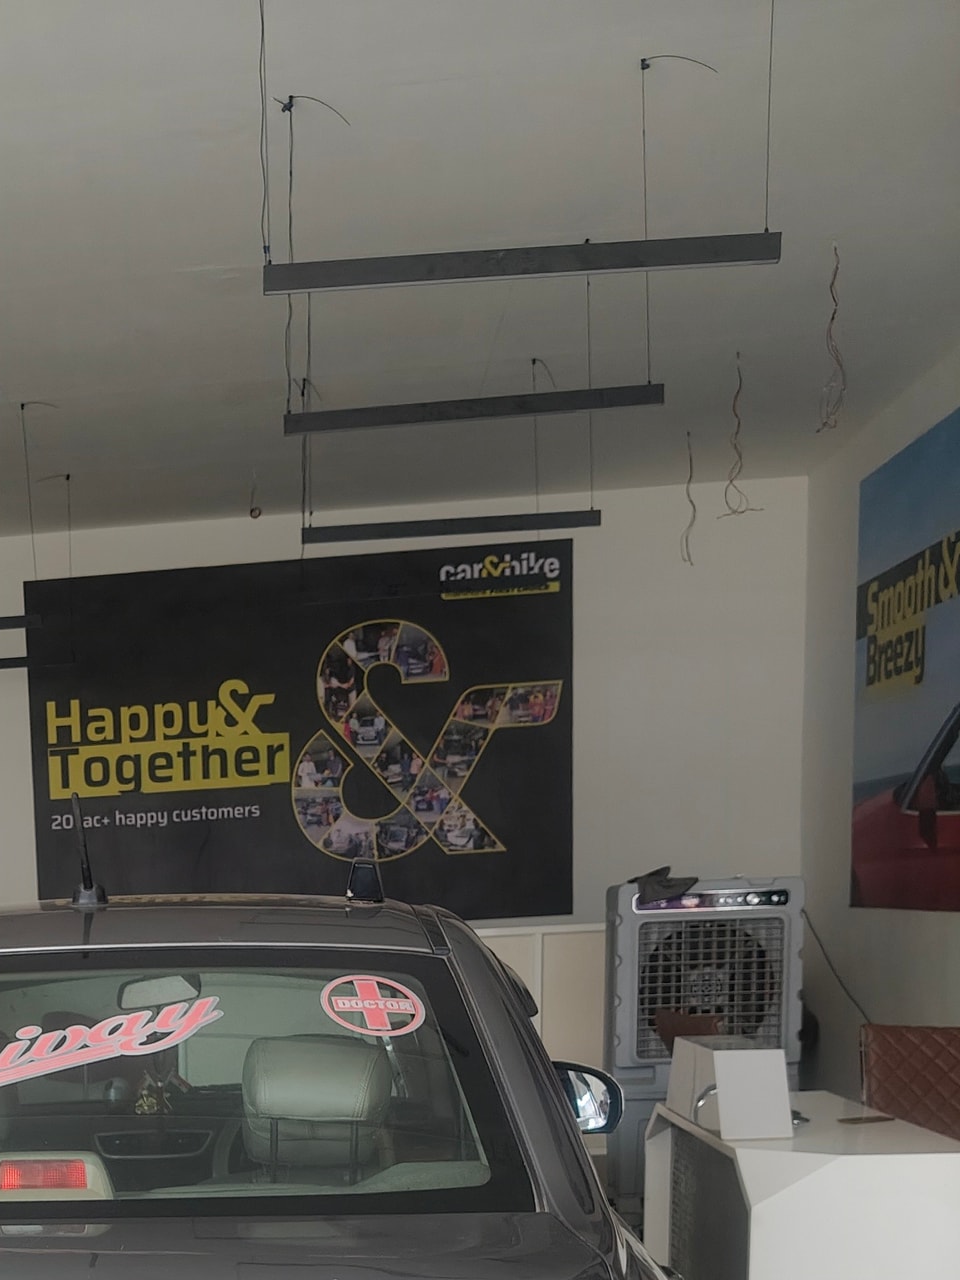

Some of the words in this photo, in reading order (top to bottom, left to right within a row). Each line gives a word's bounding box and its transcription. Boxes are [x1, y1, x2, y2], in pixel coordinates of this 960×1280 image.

[867, 548, 936, 632] Smooth
[867, 625, 926, 686] Breezy
[49, 742, 284, 792] Together
[51, 814, 74, 830] 20
[75, 815, 111, 829] ac+
[115, 810, 168, 827] happy
[172, 804, 260, 823] customers
[337, 999, 414, 1012] DOCTOR
